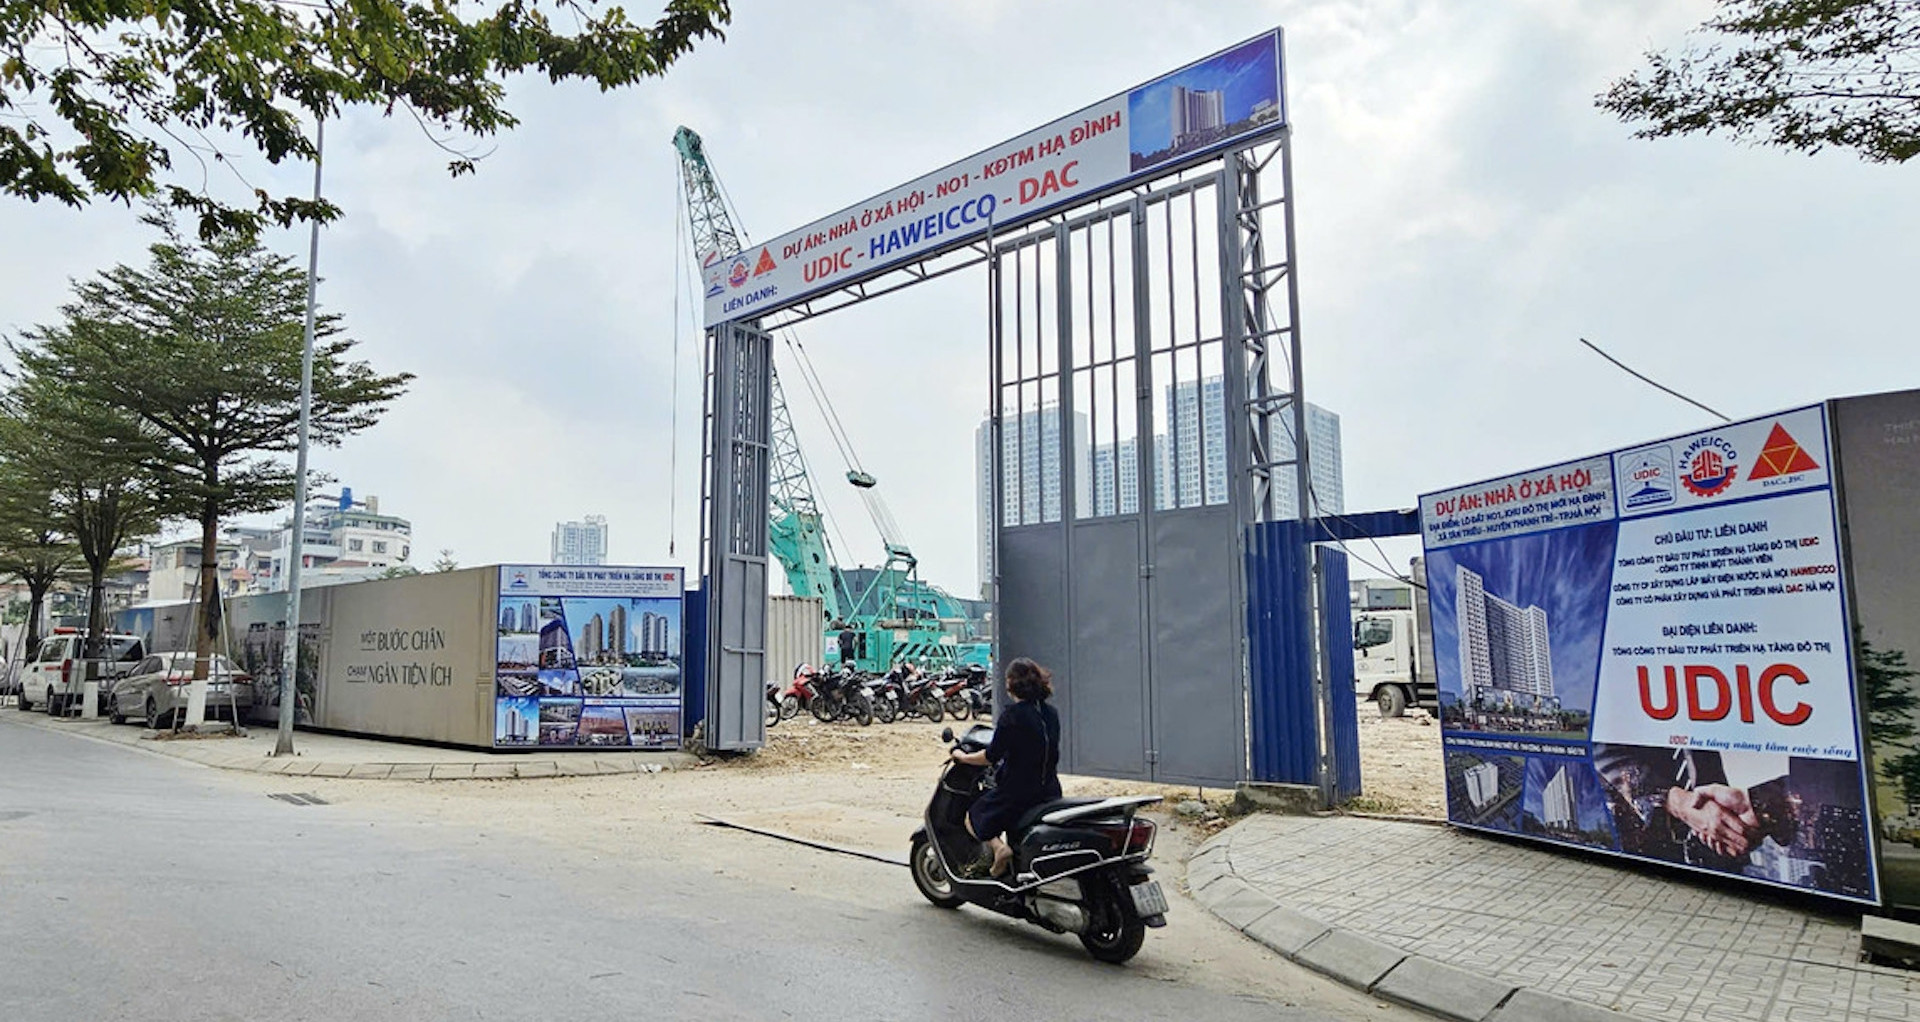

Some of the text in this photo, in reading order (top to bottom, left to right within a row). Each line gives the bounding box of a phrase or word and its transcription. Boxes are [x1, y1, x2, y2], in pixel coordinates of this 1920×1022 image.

[783, 238, 803, 260] DỰ
[804, 234, 827, 252] ÁN:
[828, 216, 859, 242] NHÀ
[861, 208, 873, 228] Ở
[875, 200, 895, 224] XÃ
[897, 190, 925, 213] HỘI
[984, 146, 1034, 179] KĐTM
[1039, 134, 1066, 158] HẠ
[1069, 110, 1121, 146] ĐÌNH
[803, 246, 853, 284] UDIC
[868, 192, 996, 260] HAWEICCO
[1019, 160, 1079, 205] DAC
[723, 285, 778, 314] LIÊN DANH:
[1679, 436, 1738, 470] HAWEICCO
[1633, 467, 1661, 481] UDIC
[1436, 468, 1592, 518] DỰ ÁN: NHÀ Ở XÃ HỘI
[1654, 519, 1769, 546] CHỦ ĐẦU TƯ: LIÊN DANH
[1799, 536, 1820, 547] UDIC
[1789, 564, 1836, 577] HAWEICCO
[1785, 583, 1804, 594] DAC
[1805, 580, 1819, 592] HÀ
[1819, 579, 1836, 592] NỘI
[361, 626, 446, 652] MỘT BƯỚC CHÂN
[1662, 621, 1758, 639] ĐẠI DIỆN LIÊN DANH:
[1633, 645, 1655, 656] CÔNG
[1656, 646, 1667, 655] TY
[1667, 645, 1686, 655] ĐẦU
[1686, 645, 1699, 654] TƯ
[1700, 642, 1723, 655] PHÁT
[1724, 643, 1752, 654] TRIỂN
[1752, 642, 1767, 655] HẠ
[1767, 640, 1795, 653] TẦNG
[1796, 639, 1812, 653] ĐÔ
[1813, 641, 1832, 654] THỊ
[367, 660, 400, 685] NGÀN
[401, 661, 427, 689] TIỆN
[430, 661, 453, 687] ÍCH
[1636, 663, 1813, 726] UDIC
[1669, 735, 1688, 745] UDIC
